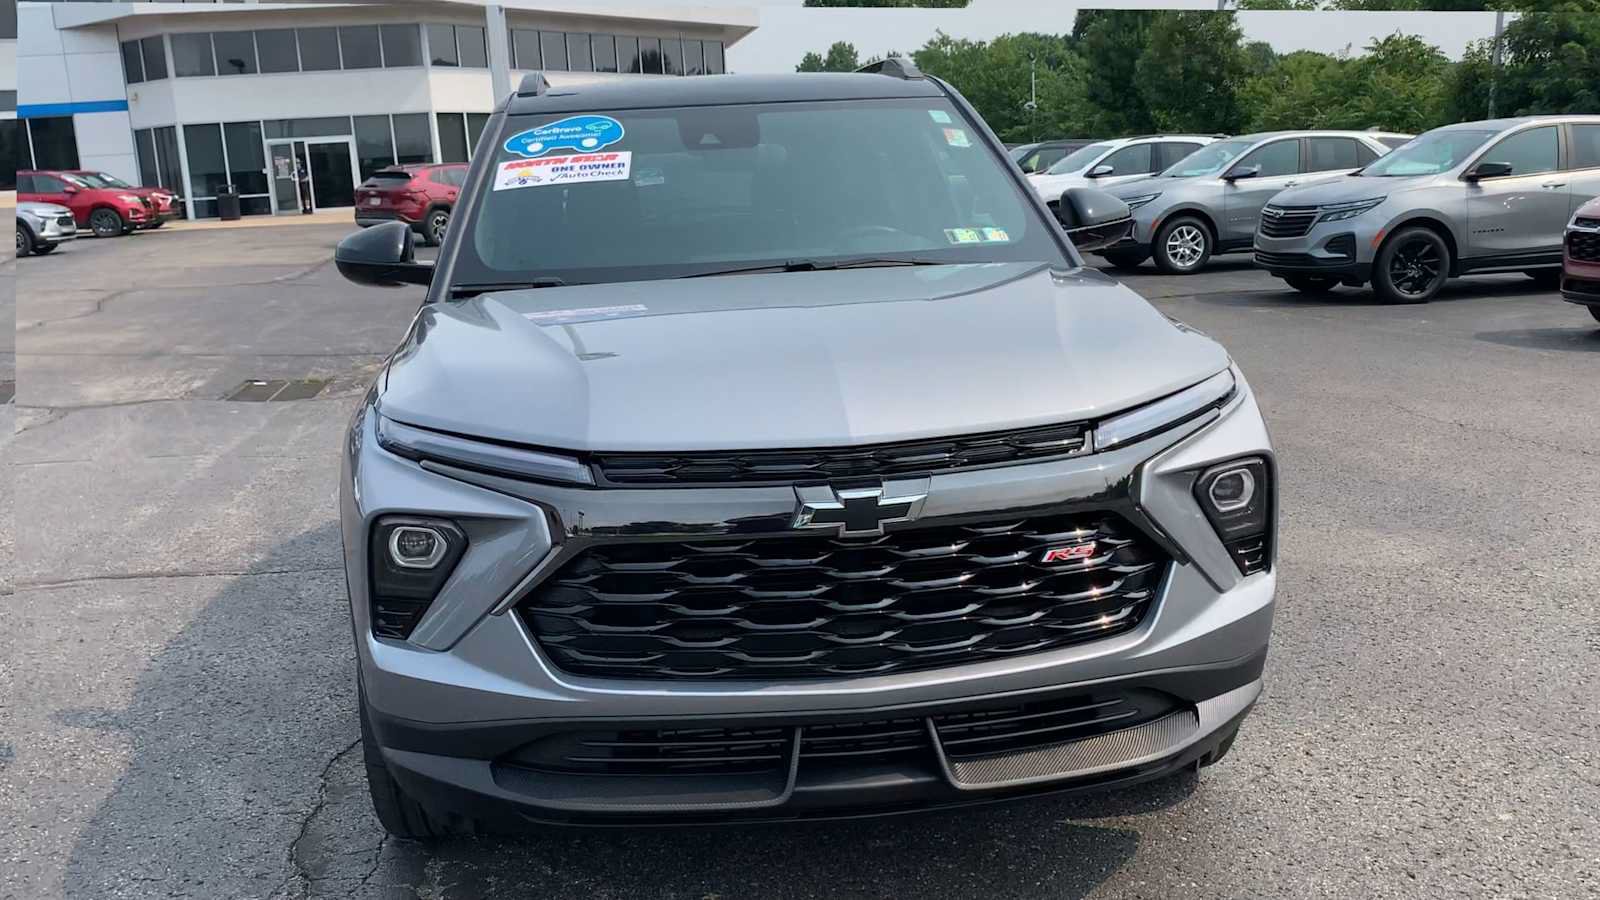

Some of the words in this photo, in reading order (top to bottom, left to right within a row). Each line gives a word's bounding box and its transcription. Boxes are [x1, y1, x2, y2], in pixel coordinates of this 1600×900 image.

[534, 126, 582, 136] CarBravo
[521, 136, 557, 144] Certified
[504, 157, 569, 170] NORTH
[551, 165, 576, 173] ONE
[579, 162, 626, 171] OWNER
[1041, 542, 1096, 563] RS
